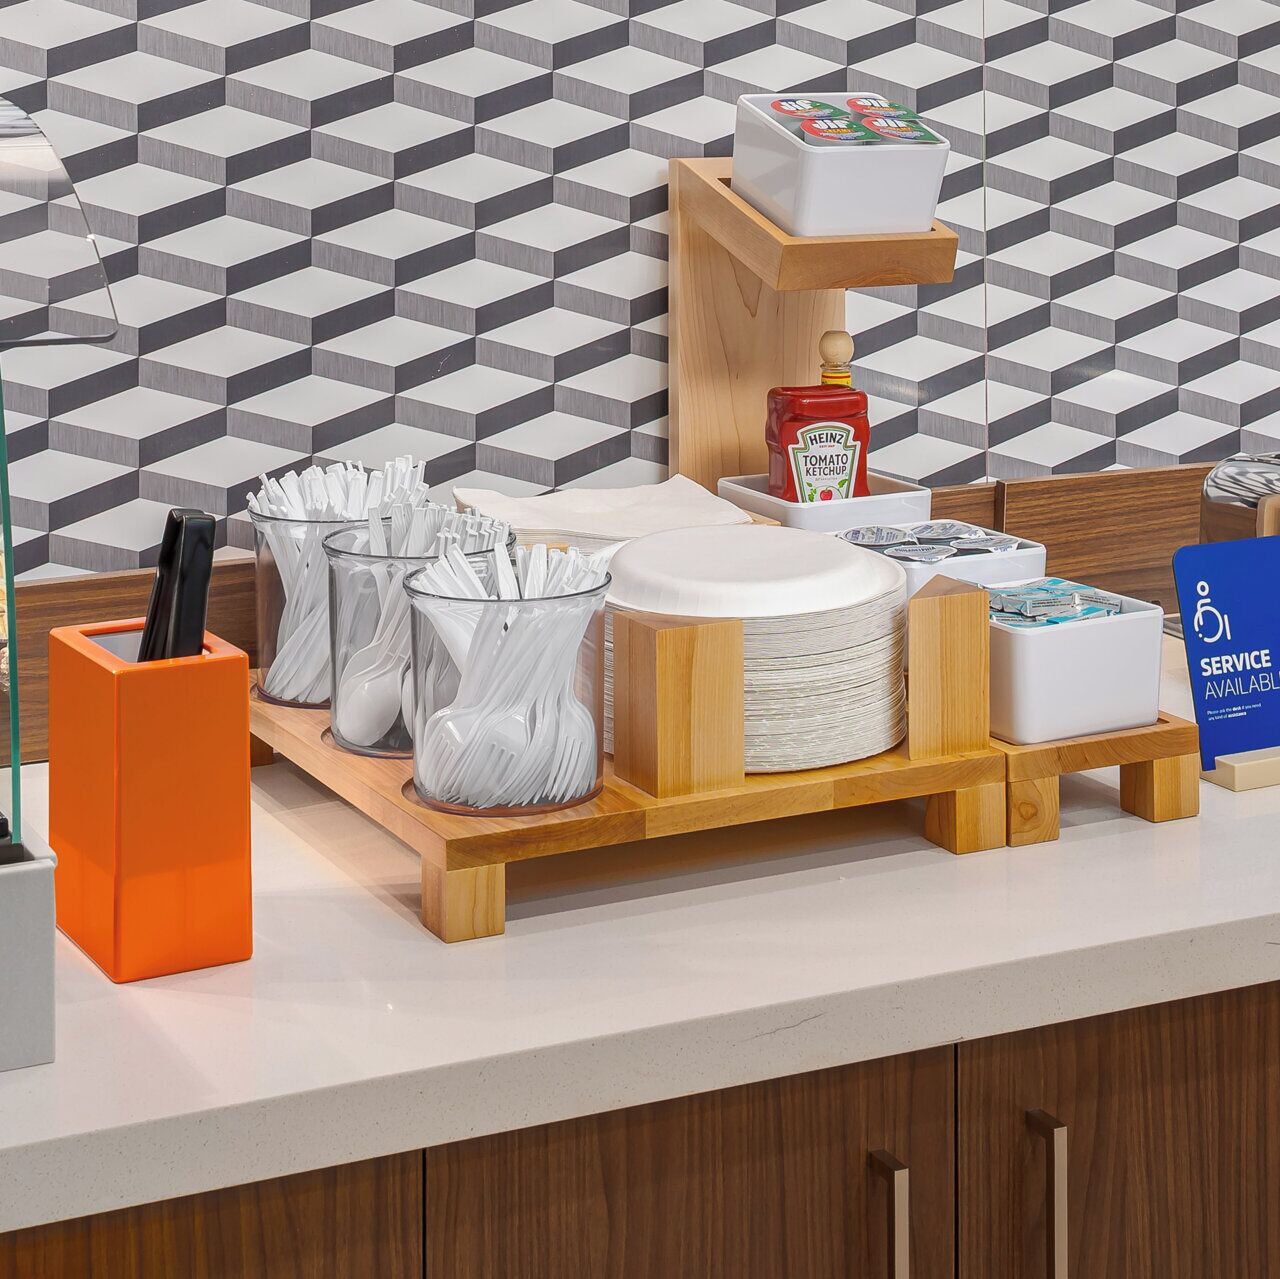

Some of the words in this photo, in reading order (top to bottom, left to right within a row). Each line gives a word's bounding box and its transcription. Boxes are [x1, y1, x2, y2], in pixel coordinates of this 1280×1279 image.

[809, 432, 845, 445] HEINZ
[803, 453, 848, 467] TOMATO
[805, 466, 847, 477] KETCHUP
[1200, 649, 1272, 677] SERVICE
